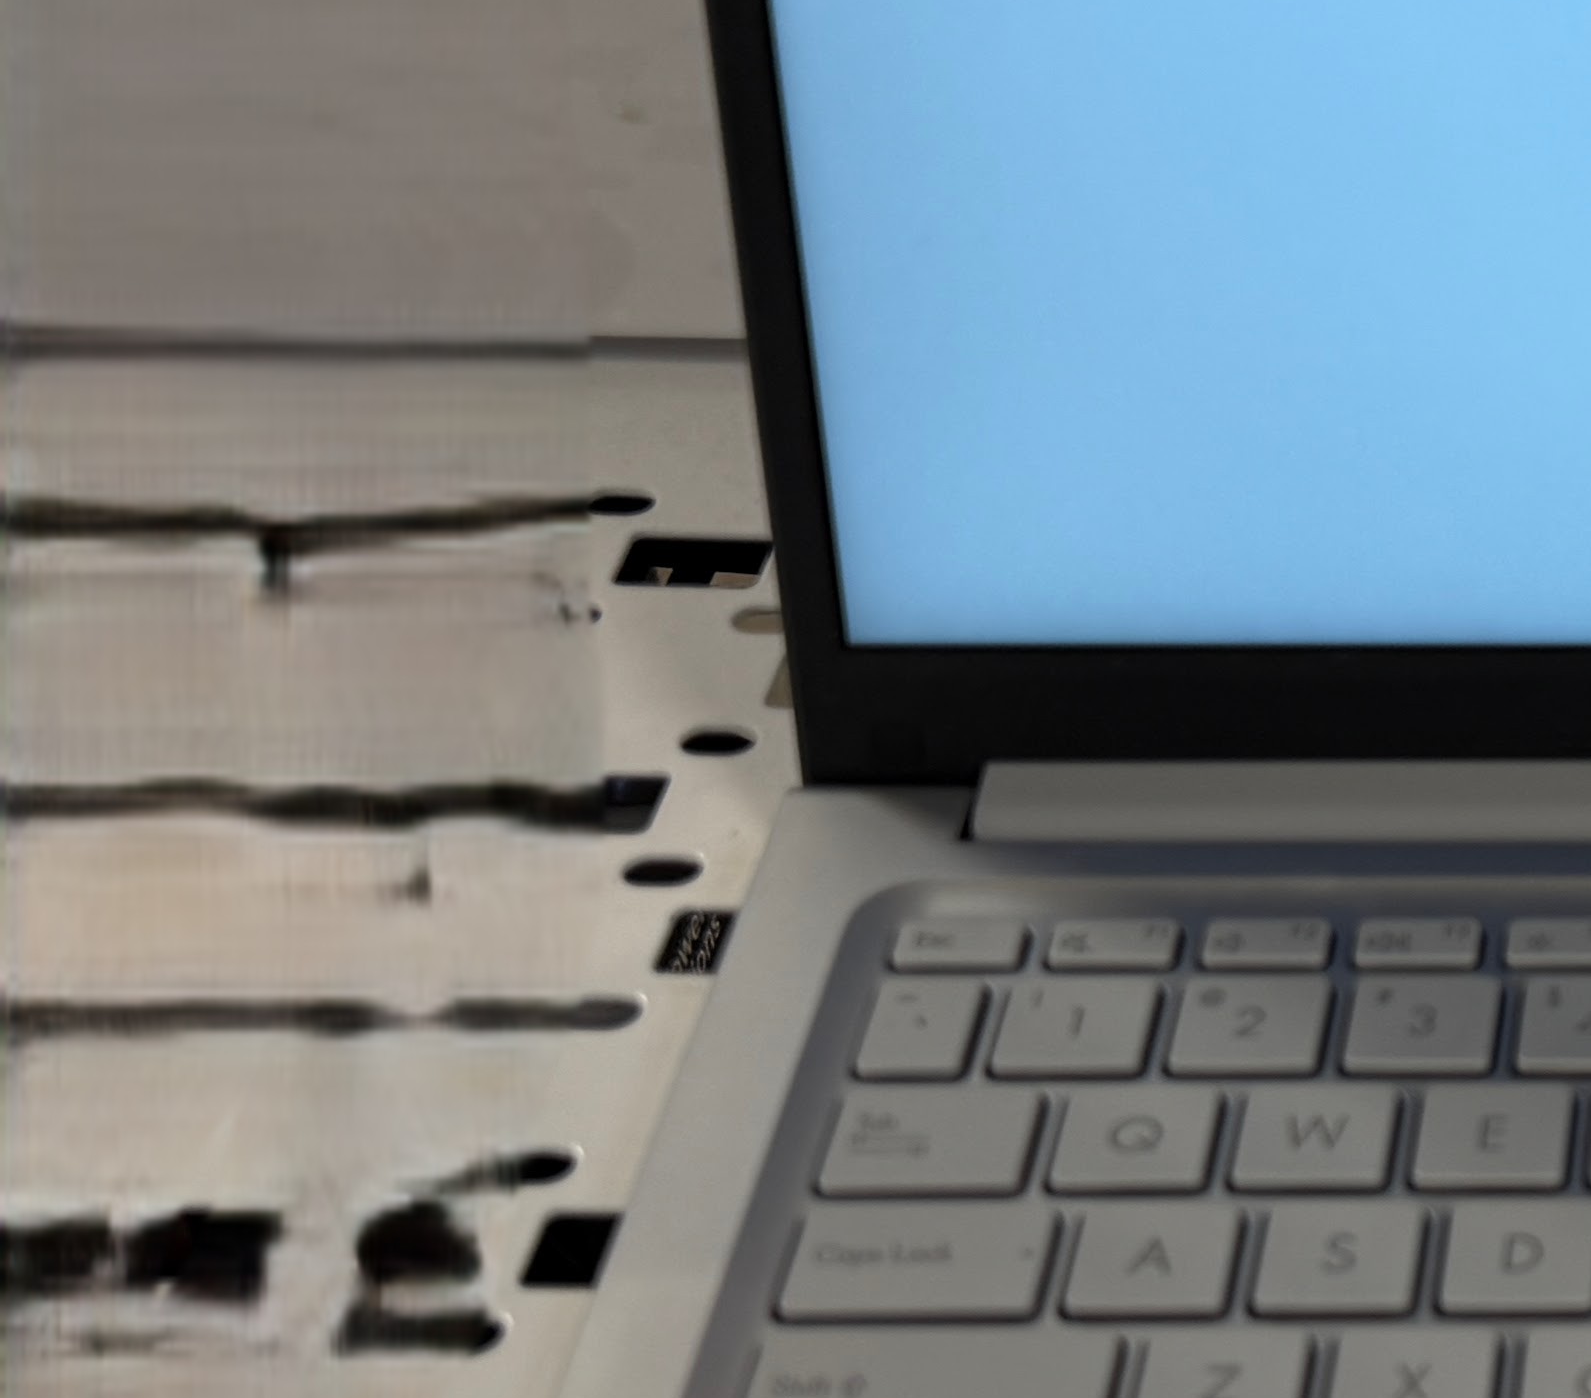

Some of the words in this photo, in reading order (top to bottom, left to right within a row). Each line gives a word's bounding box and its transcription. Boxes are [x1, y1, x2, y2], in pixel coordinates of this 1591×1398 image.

[1232, 1005, 1267, 1038] 2
[1408, 1005, 1438, 1038] 3
[1108, 1114, 1165, 1155] Q
[1286, 1113, 1349, 1152] W
[1476, 1113, 1507, 1152] E
[1123, 1235, 1172, 1276] A
[1319, 1230, 1359, 1274] S
[1501, 1230, 1545, 1274] D
